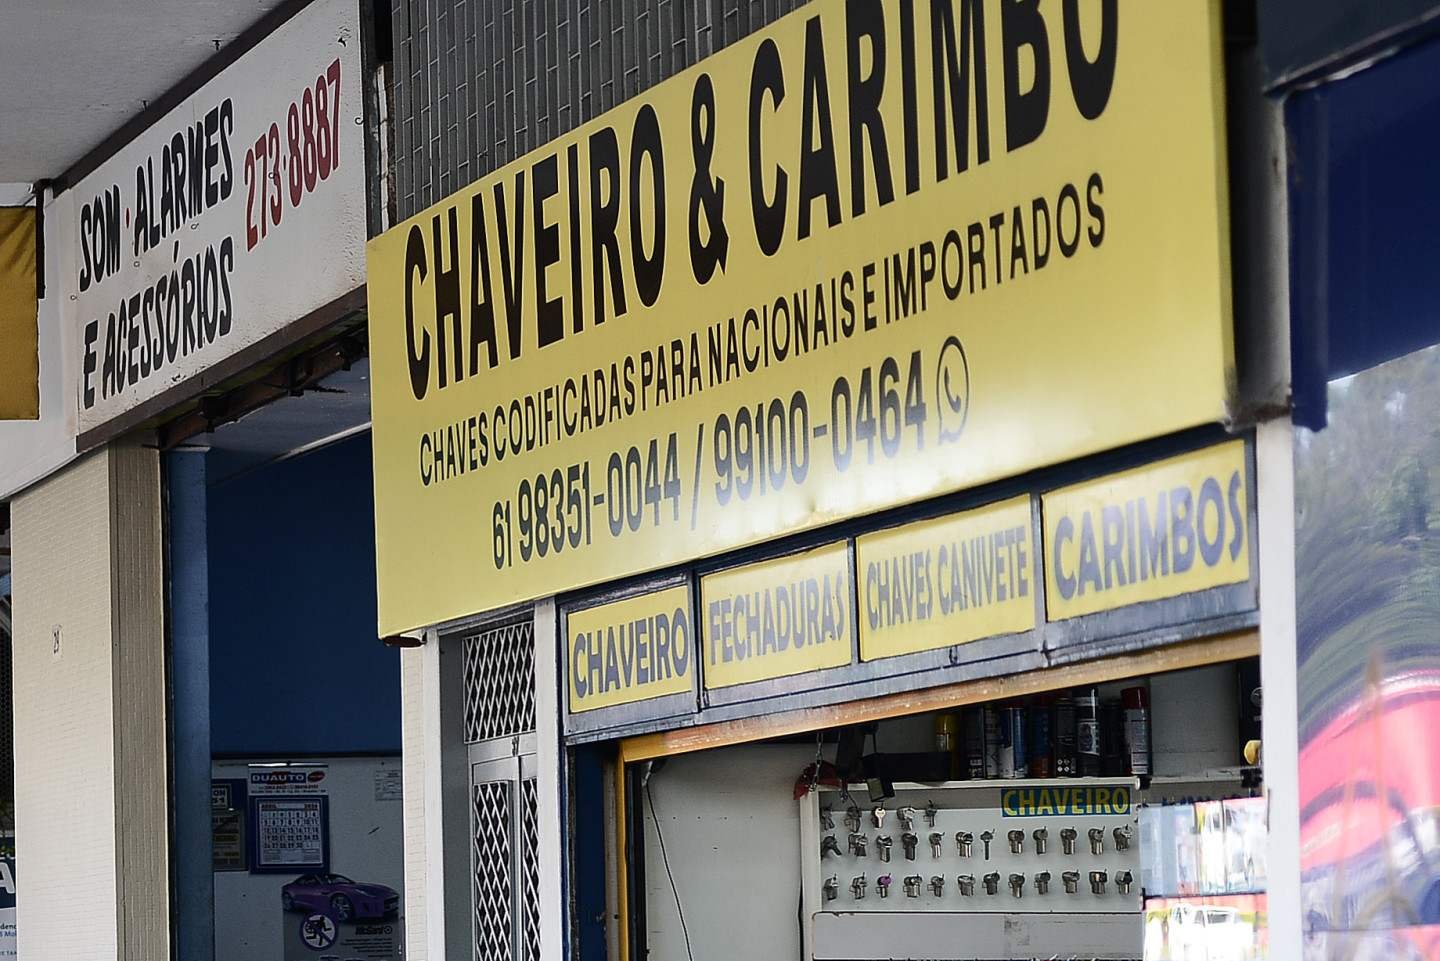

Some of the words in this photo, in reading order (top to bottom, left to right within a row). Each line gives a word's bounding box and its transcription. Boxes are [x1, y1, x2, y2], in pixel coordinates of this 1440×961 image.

[79, 184, 122, 293] SOM
[134, 97, 234, 257] ALARMES
[404, 103, 666, 401] CHAVEIRO
[688, 73, 729, 286] &
[82, 319, 99, 410] E
[102, 235, 234, 401] ACESSÓRIOS
[419, 416, 489, 488] CHAVES
[491, 354, 635, 462] CODIFICADAS
[641, 331, 704, 409] PARA
[708, 270, 856, 388] NACIONAIS
[861, 262, 878, 333] E
[883, 171, 1106, 326] IMPORTADOS
[491, 497, 513, 571] 61
[517, 431, 682, 563] 98351-0044
[713, 349, 928, 508] 99100-0464
[1052, 467, 1244, 600] CARIMBOS
[572, 605, 690, 700] CHAVEIRO
[708, 569, 846, 667] FECHADURAS
[865, 549, 934, 632] CHAVES
[937, 523, 1030, 618] CANIVETE
[1002, 786, 1130, 817] CHAVEIRO
